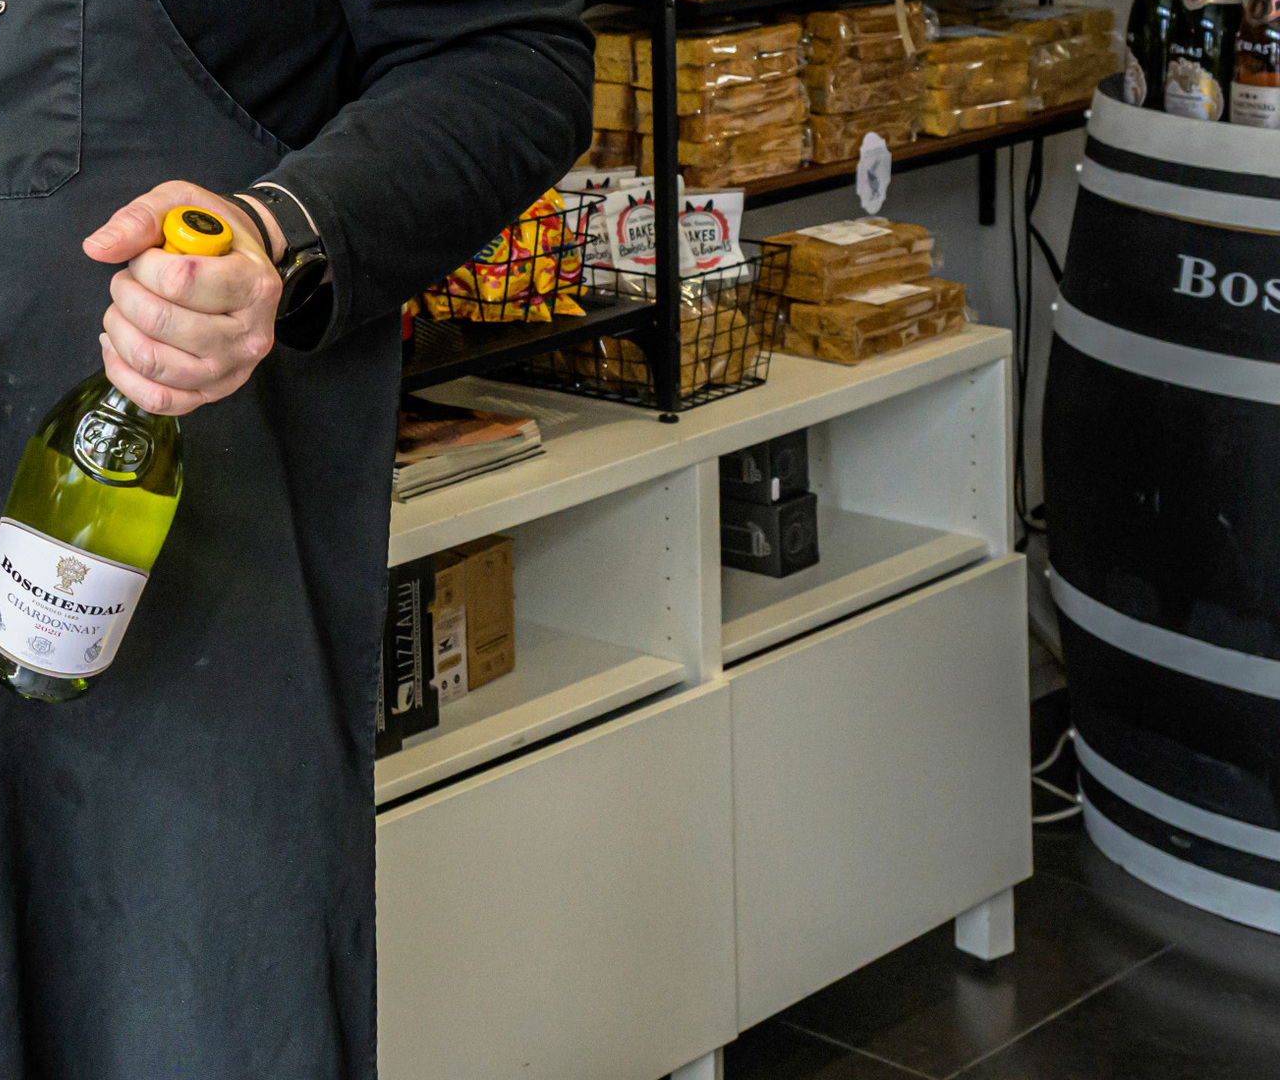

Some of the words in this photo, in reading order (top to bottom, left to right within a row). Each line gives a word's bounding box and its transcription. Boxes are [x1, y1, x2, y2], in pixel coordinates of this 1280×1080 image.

[82, 422, 143, 464] 1685
[0, 554, 126, 616] BOSCHENDAL
[6, 592, 101, 635] CHARDONNAY
[31, 599, 63, 617] FOUNDED
[34, 622, 62, 638] 2023
